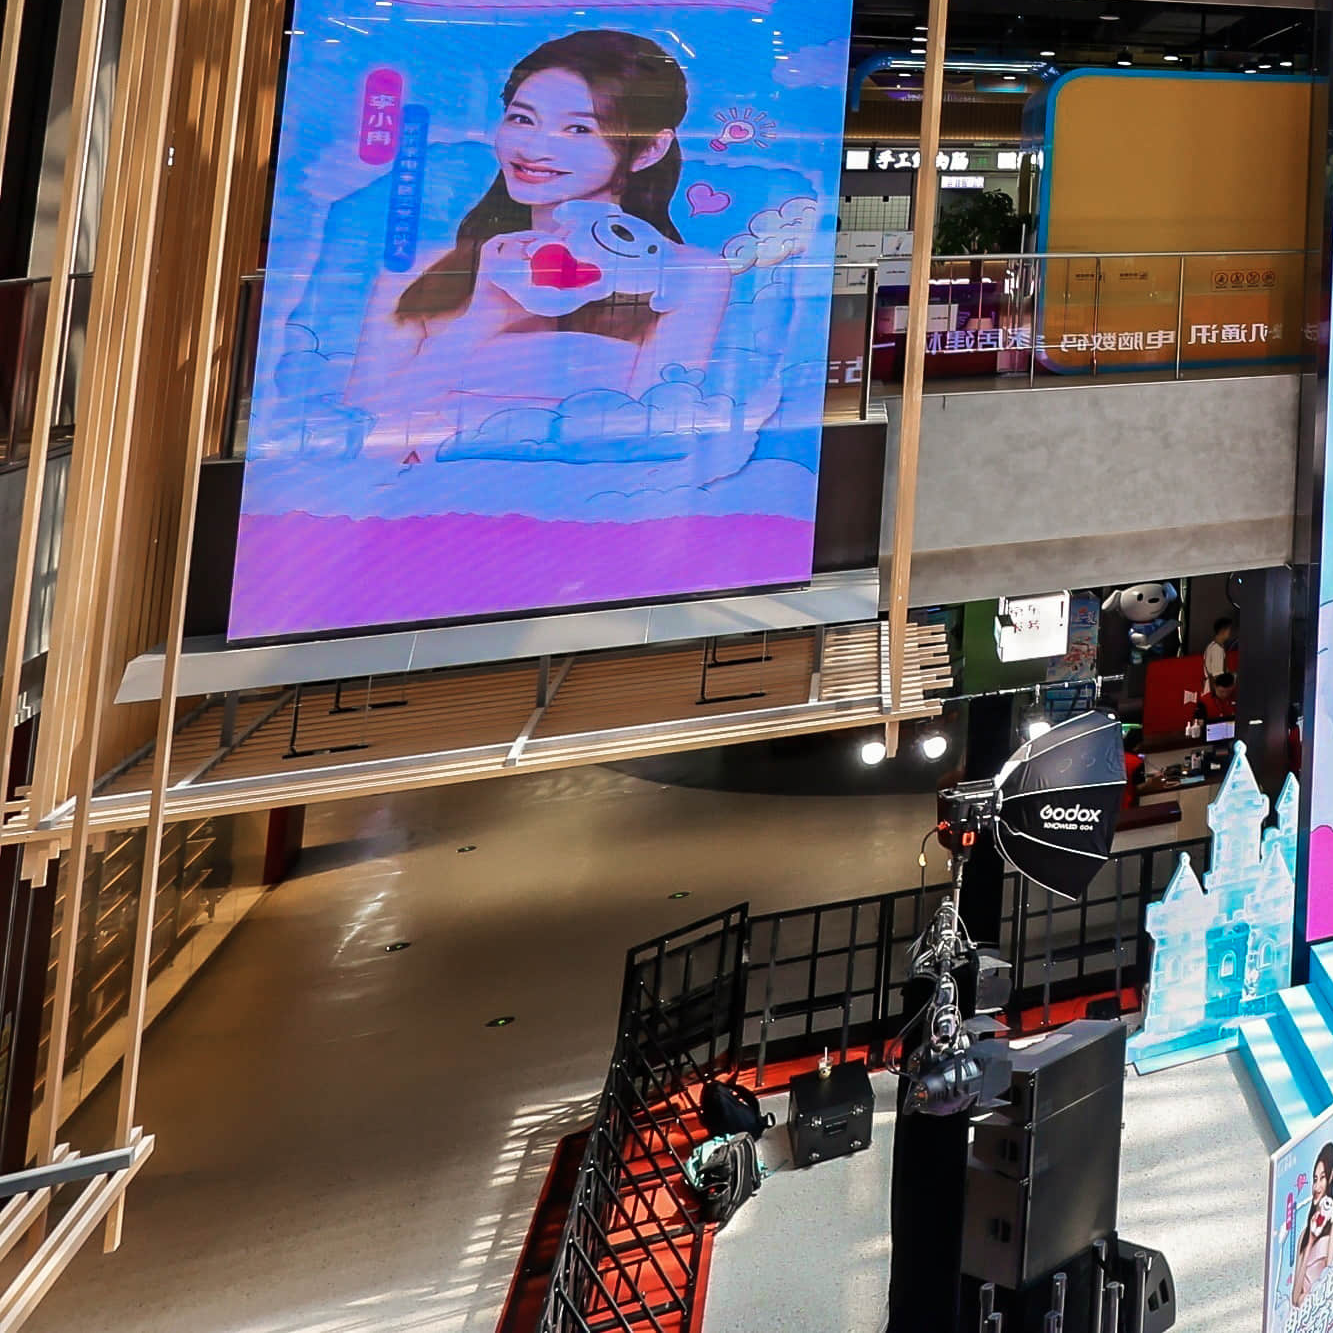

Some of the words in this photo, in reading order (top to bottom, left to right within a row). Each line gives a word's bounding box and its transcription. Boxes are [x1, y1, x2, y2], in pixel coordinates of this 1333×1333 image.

[366, 94, 396, 147] 李小冉
[1040, 803, 1102, 823] Godox
